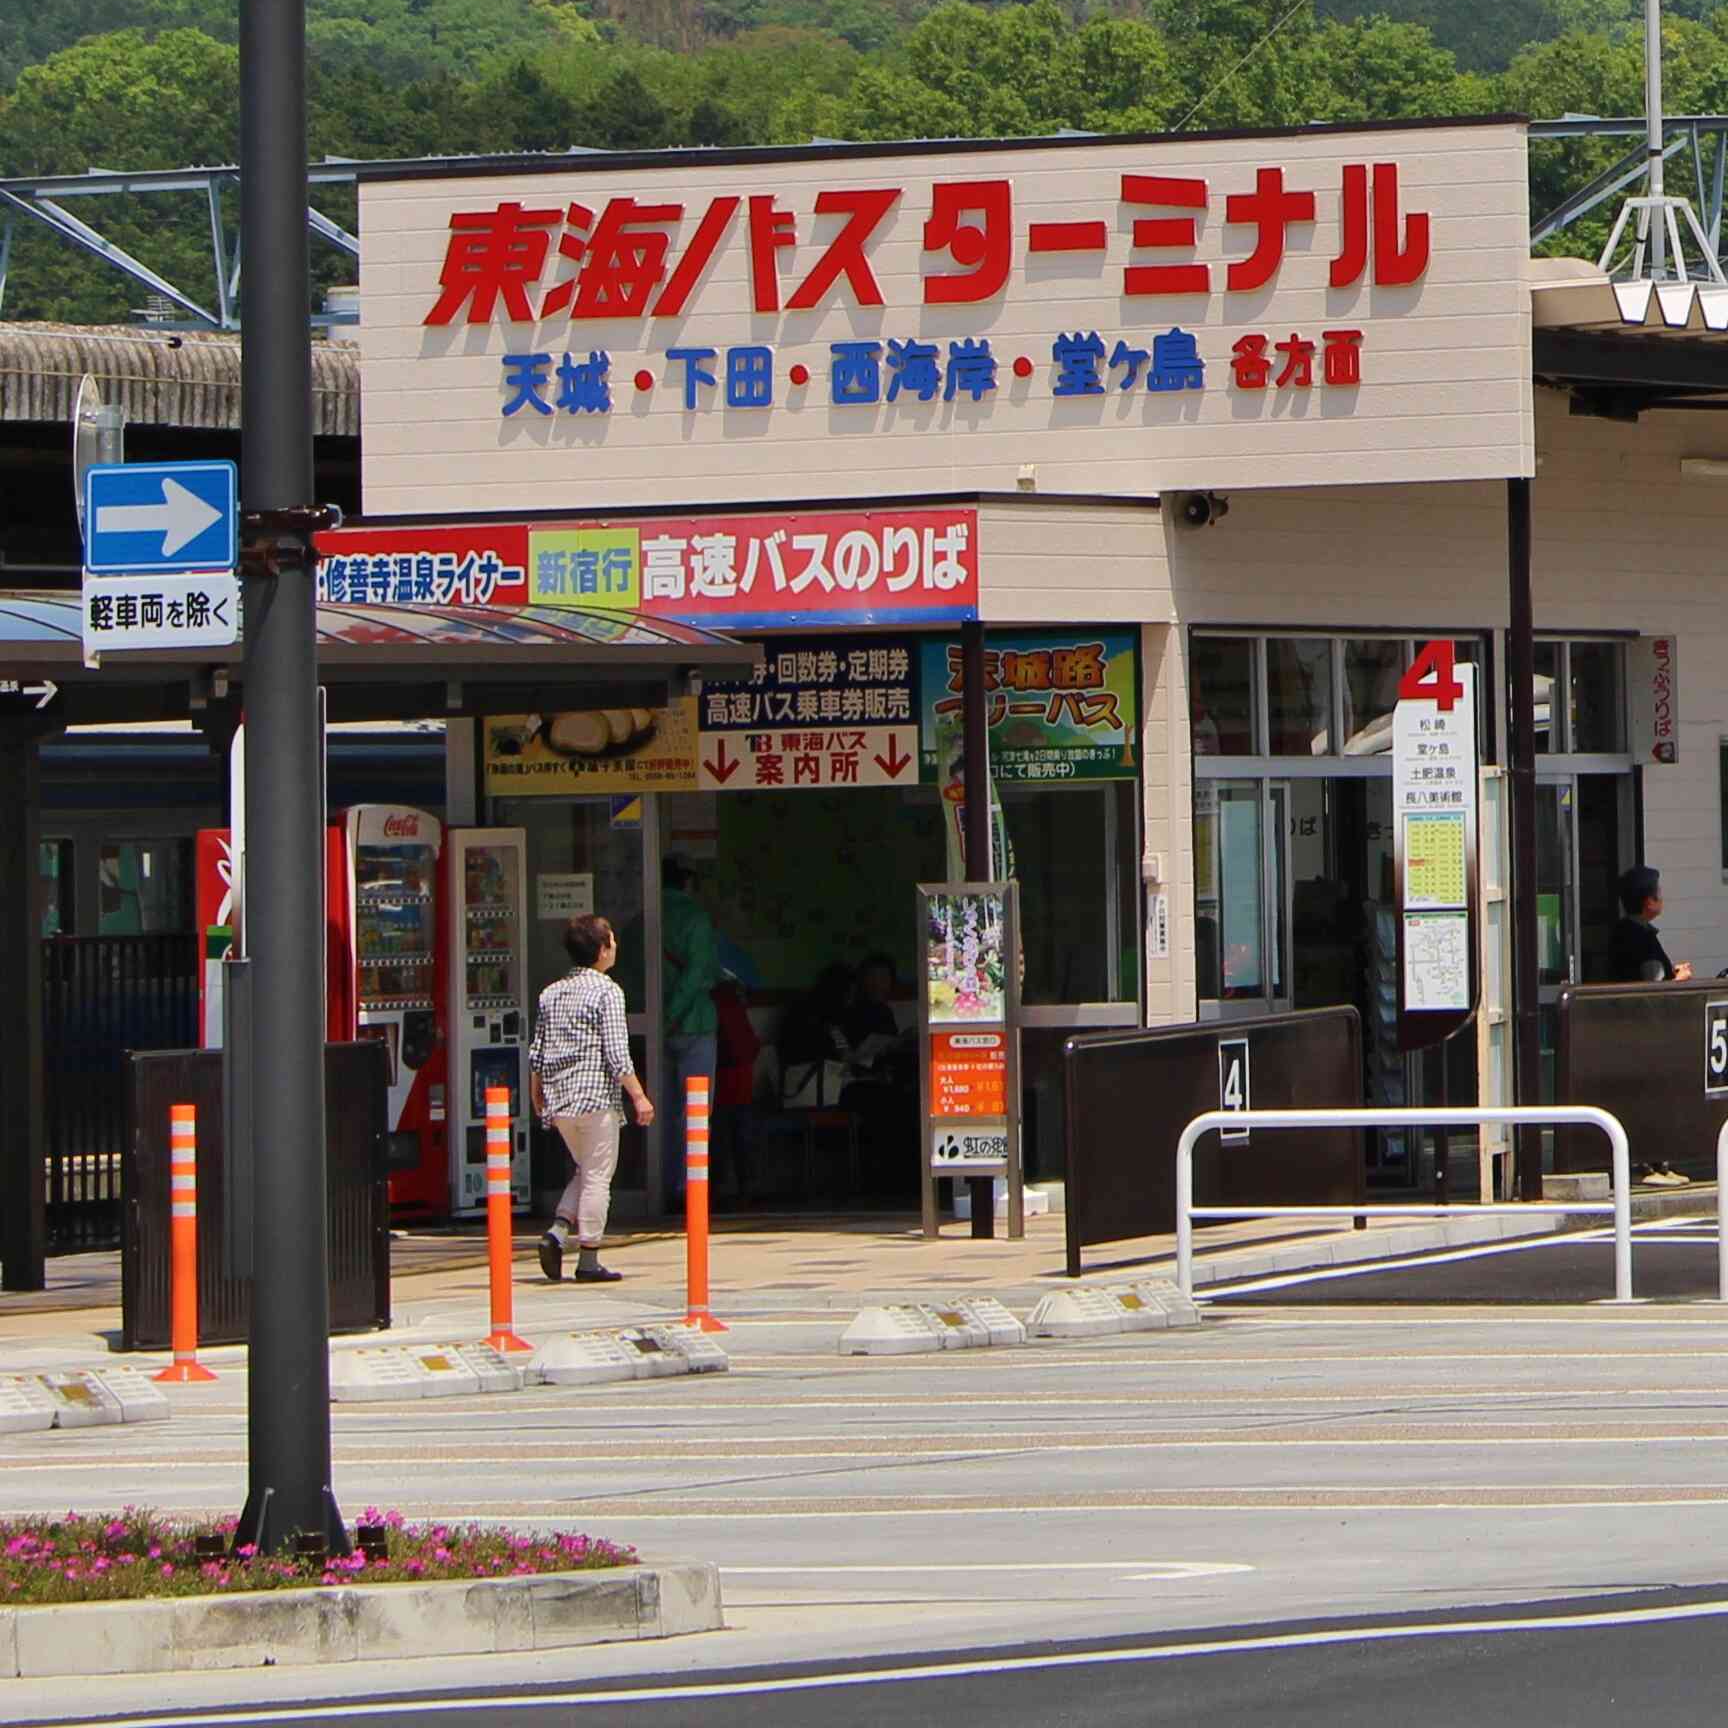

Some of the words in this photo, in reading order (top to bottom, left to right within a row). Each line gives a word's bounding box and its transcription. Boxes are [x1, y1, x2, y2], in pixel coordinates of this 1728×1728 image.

[422, 163, 1429, 327] 東海バスターミナル
[1230, 329, 1364, 391] 各方面
[537, 548, 632, 594] 新宿行
[641, 522, 969, 600] 高速バスのりば
[90, 591, 229, 632] 軽車両を除く
[1396, 638, 1464, 712] 4
[707, 688, 910, 725] 高速バス乗車券販売
[755, 751, 861, 785] 案内所
[781, 731, 868, 752] 東海バス
[1711, 1019, 1727, 1073] 5
[1224, 1058, 1243, 1113] 4
